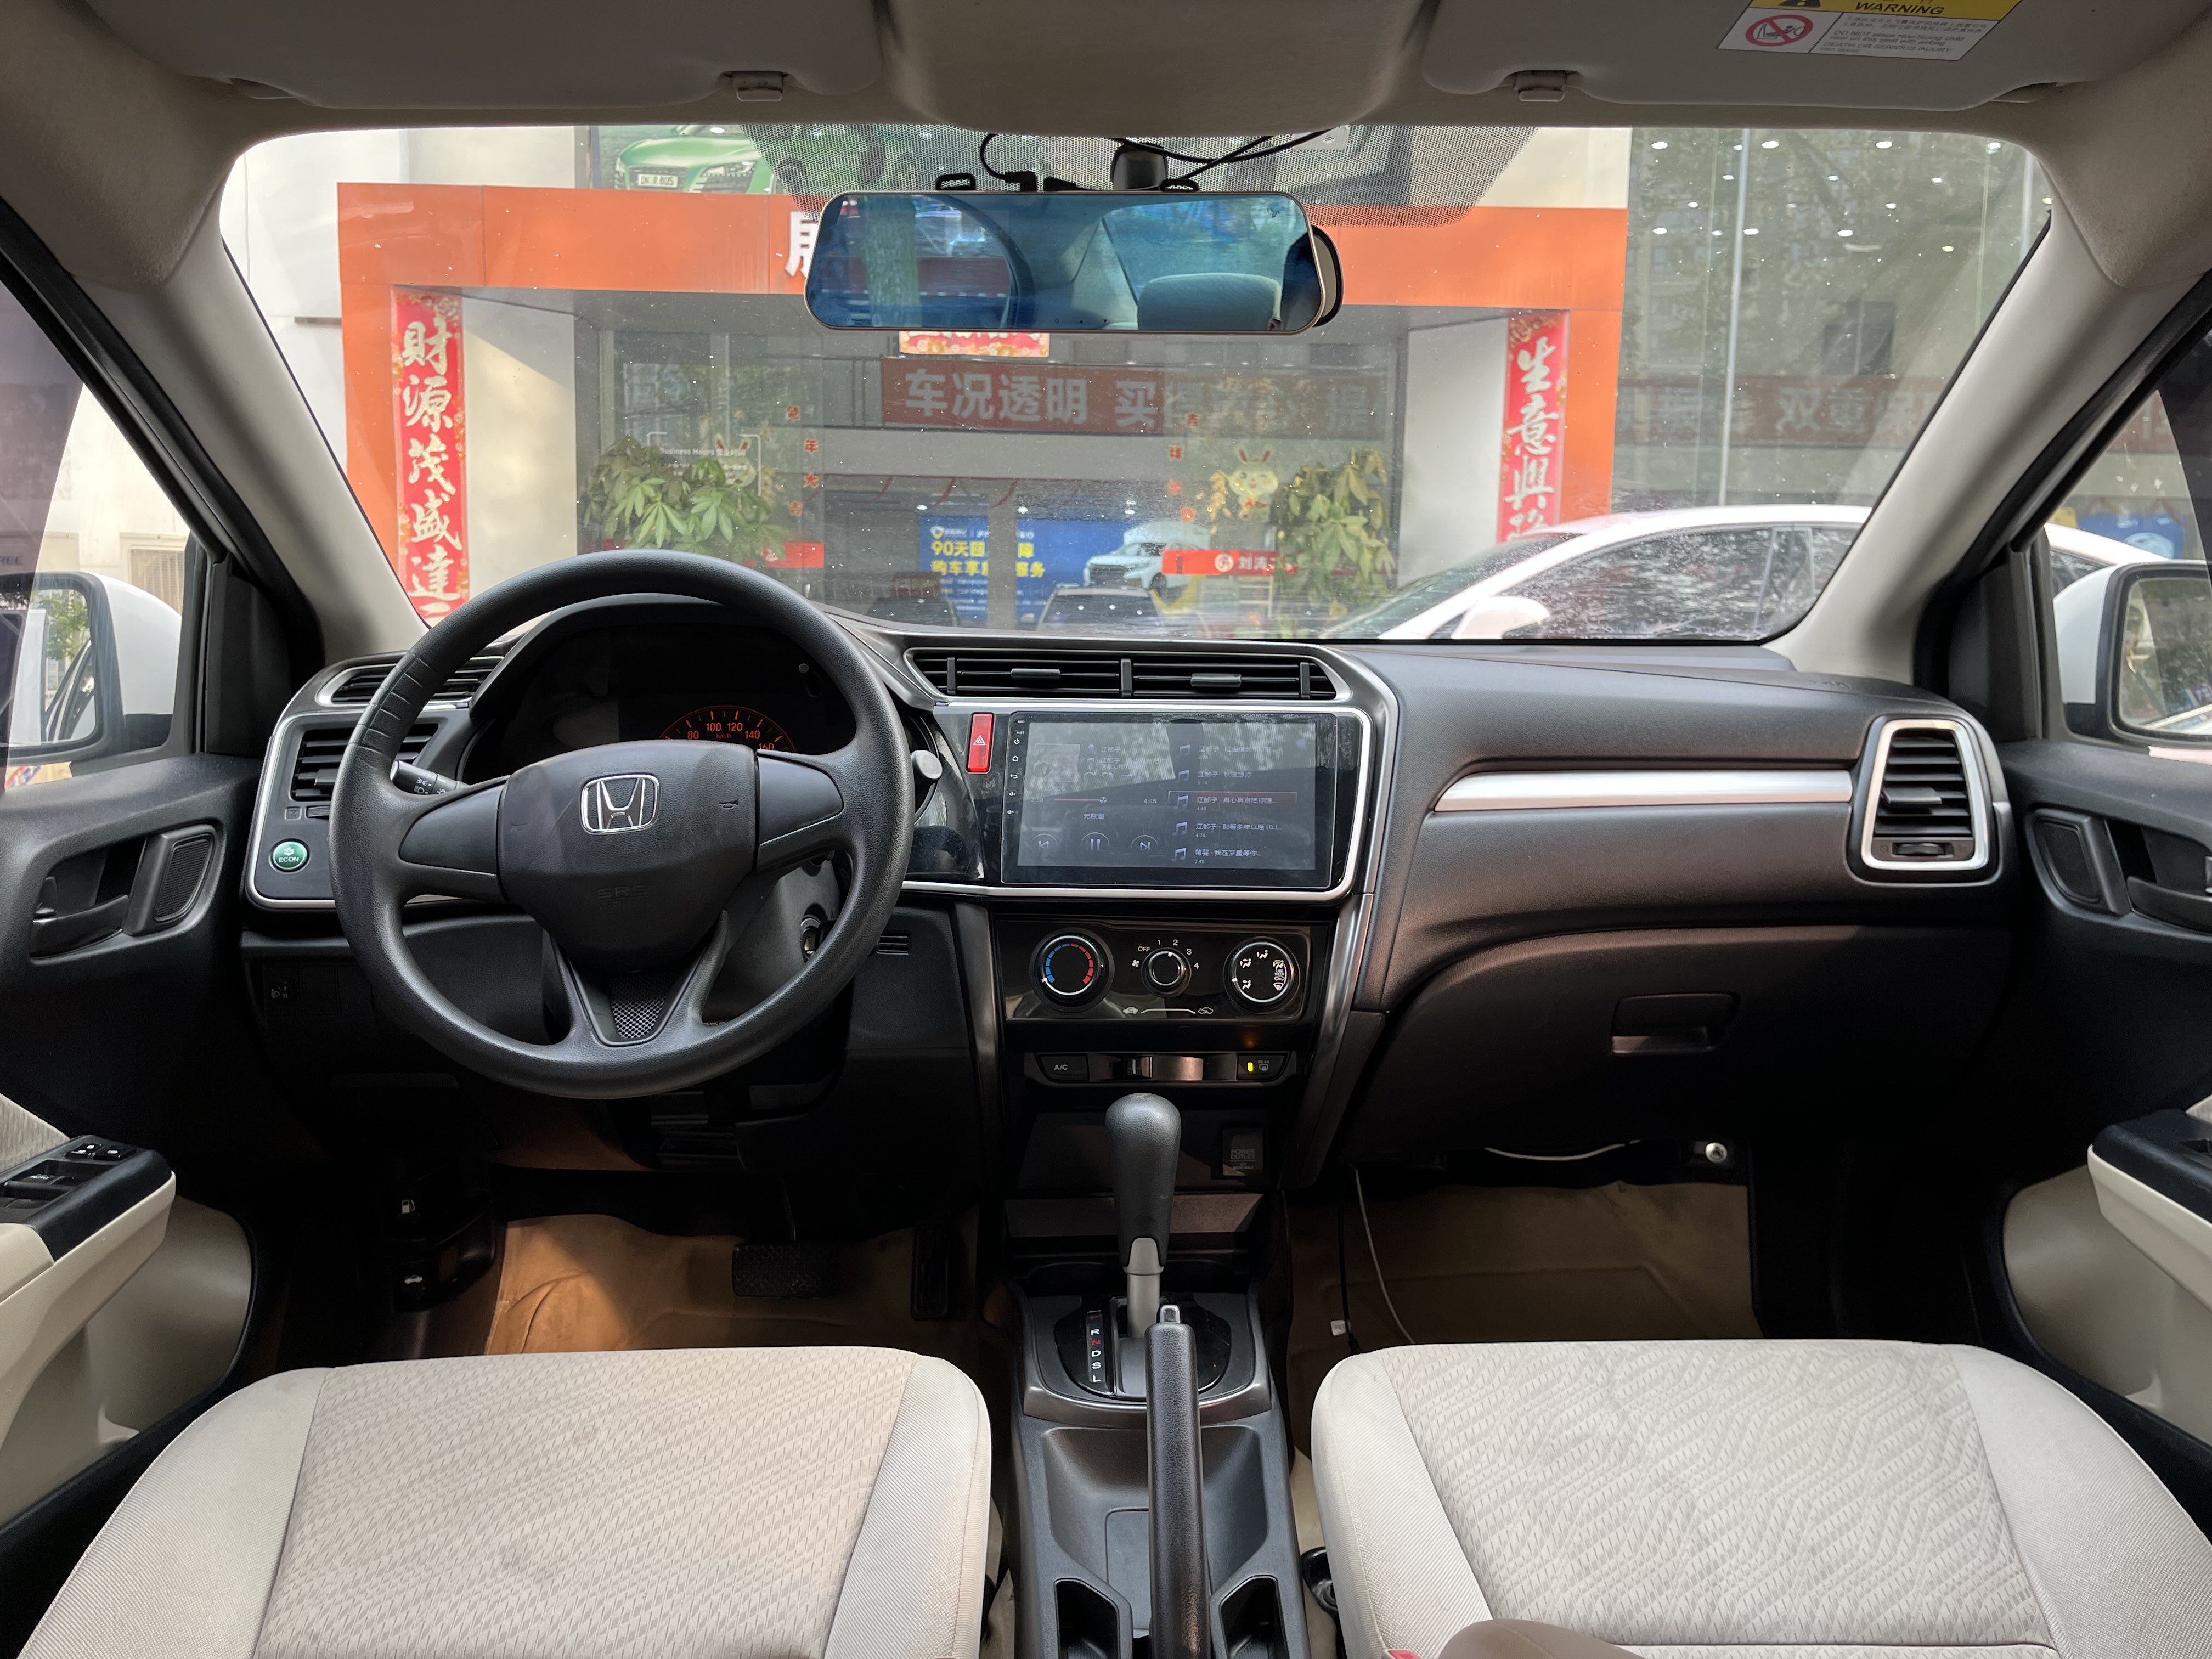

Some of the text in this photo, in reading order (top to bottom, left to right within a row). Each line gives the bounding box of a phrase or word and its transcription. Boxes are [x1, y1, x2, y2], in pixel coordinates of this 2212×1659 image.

[1855, 2, 1945, 15] WARNING
[905, 368, 1088, 425] 车况透明
[706, 722, 743, 731] 100 120
[687, 730, 699, 740] 80
[745, 730, 760, 739] 140
[597, 885, 646, 899] SRS
